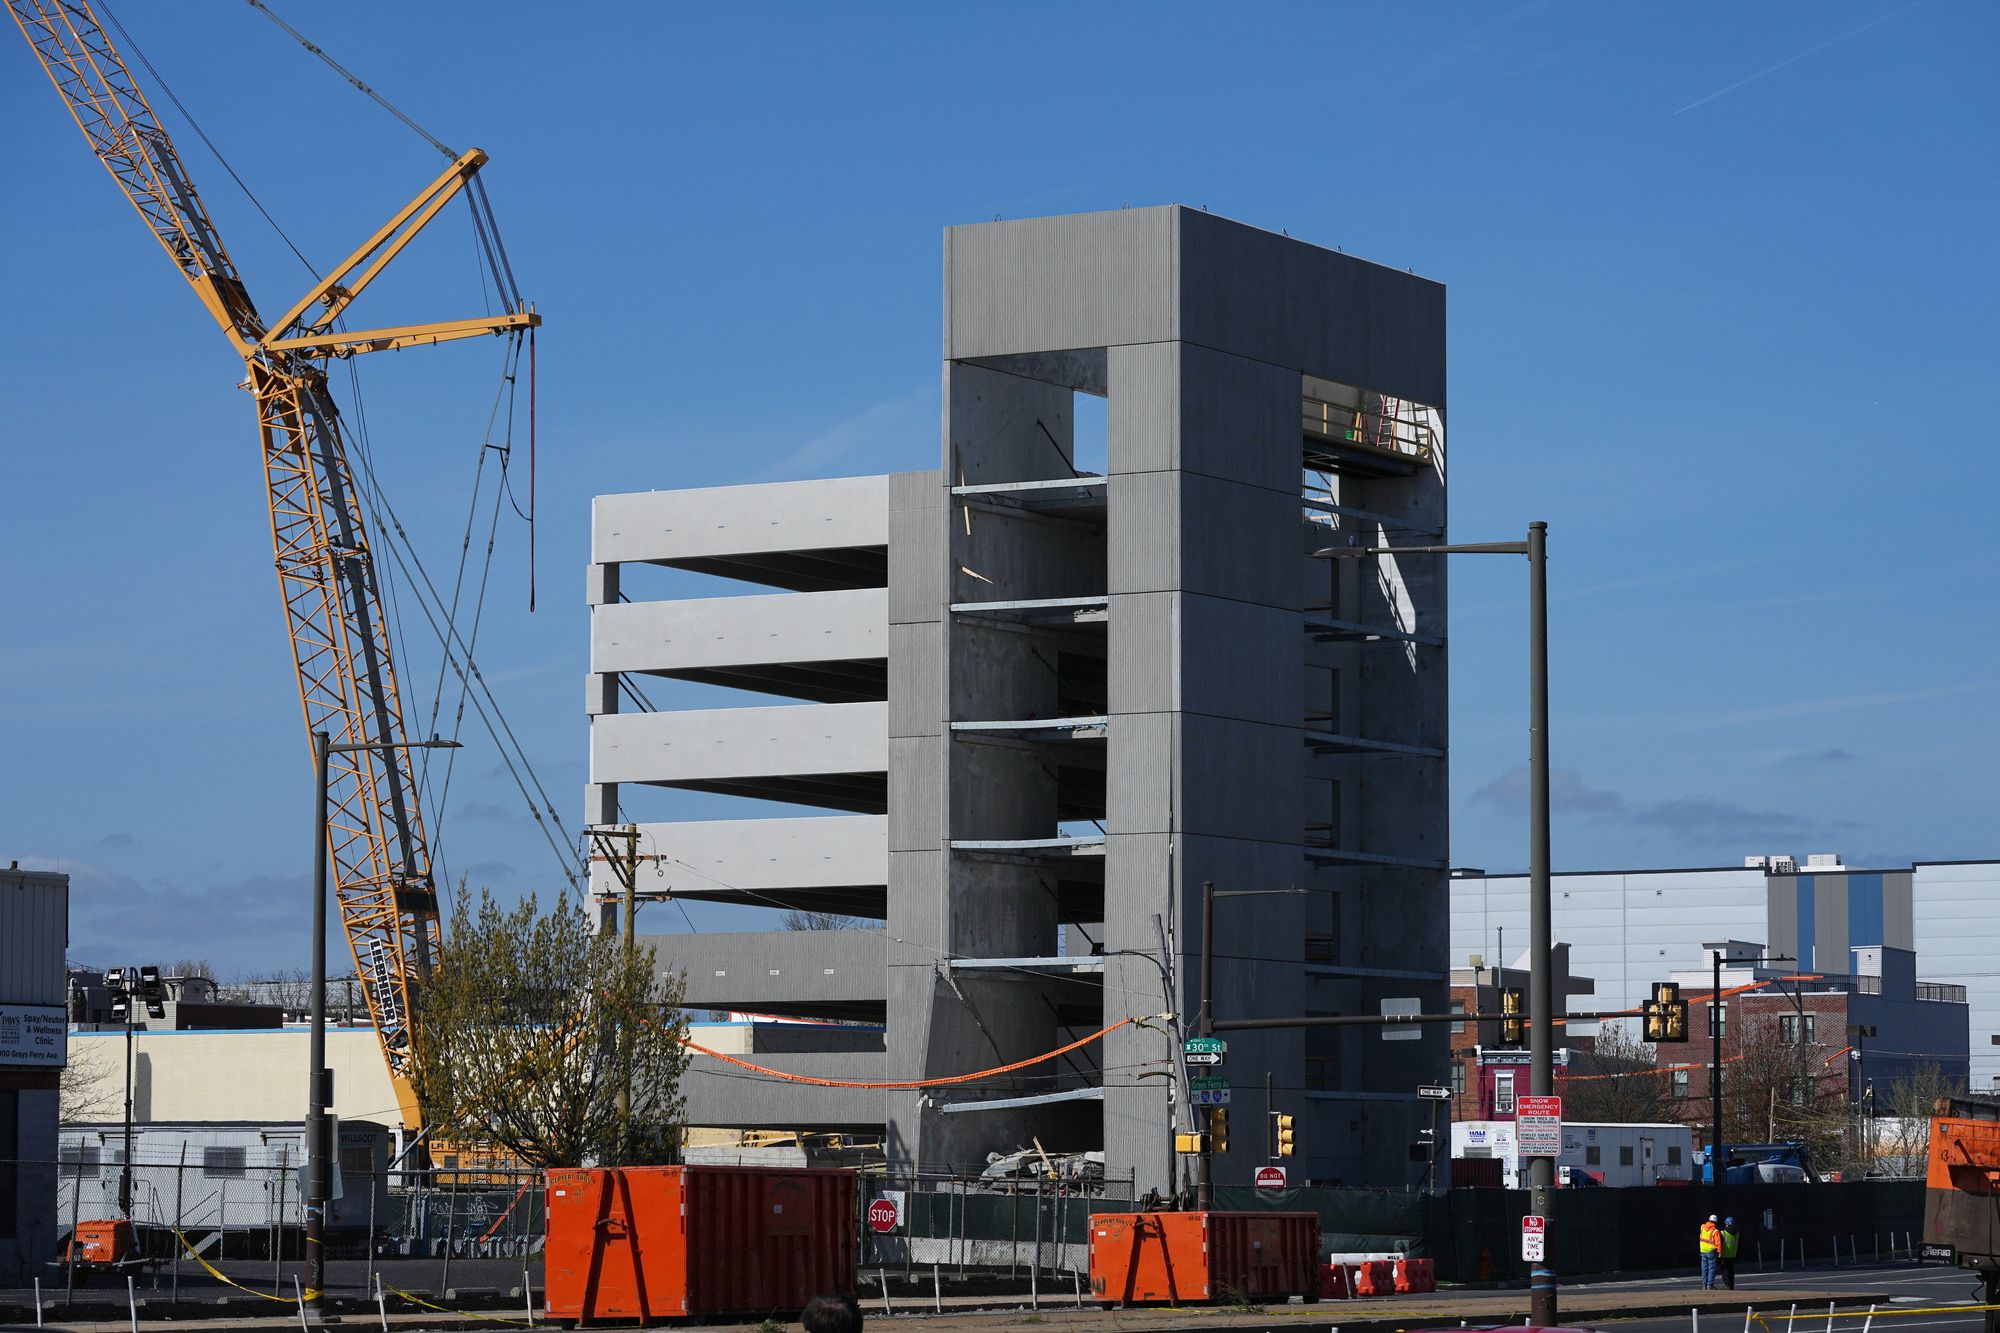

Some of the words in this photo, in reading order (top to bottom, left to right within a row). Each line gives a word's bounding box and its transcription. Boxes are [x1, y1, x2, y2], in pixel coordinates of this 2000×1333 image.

[370, 940, 398, 1022] LIEBHERR
[2, 1016, 20, 1025] PAWS
[24, 1014, 65, 1024] Spay/Neuter
[33, 1026, 62, 1034] Wellness
[35, 1037, 53, 1045] Clinic
[1192, 1043, 1209, 1051] 30th
[12, 1050, 28, 1058] Grays
[29, 1051, 45, 1060] Ferry
[1192, 1081, 1206, 1089] Grays
[1208, 1081, 1221, 1089] Ferry
[341, 1134, 376, 1142] WILLSCOT
[871, 1209, 895, 1222] STOP
[1530, 1217, 1538, 1227] NO
